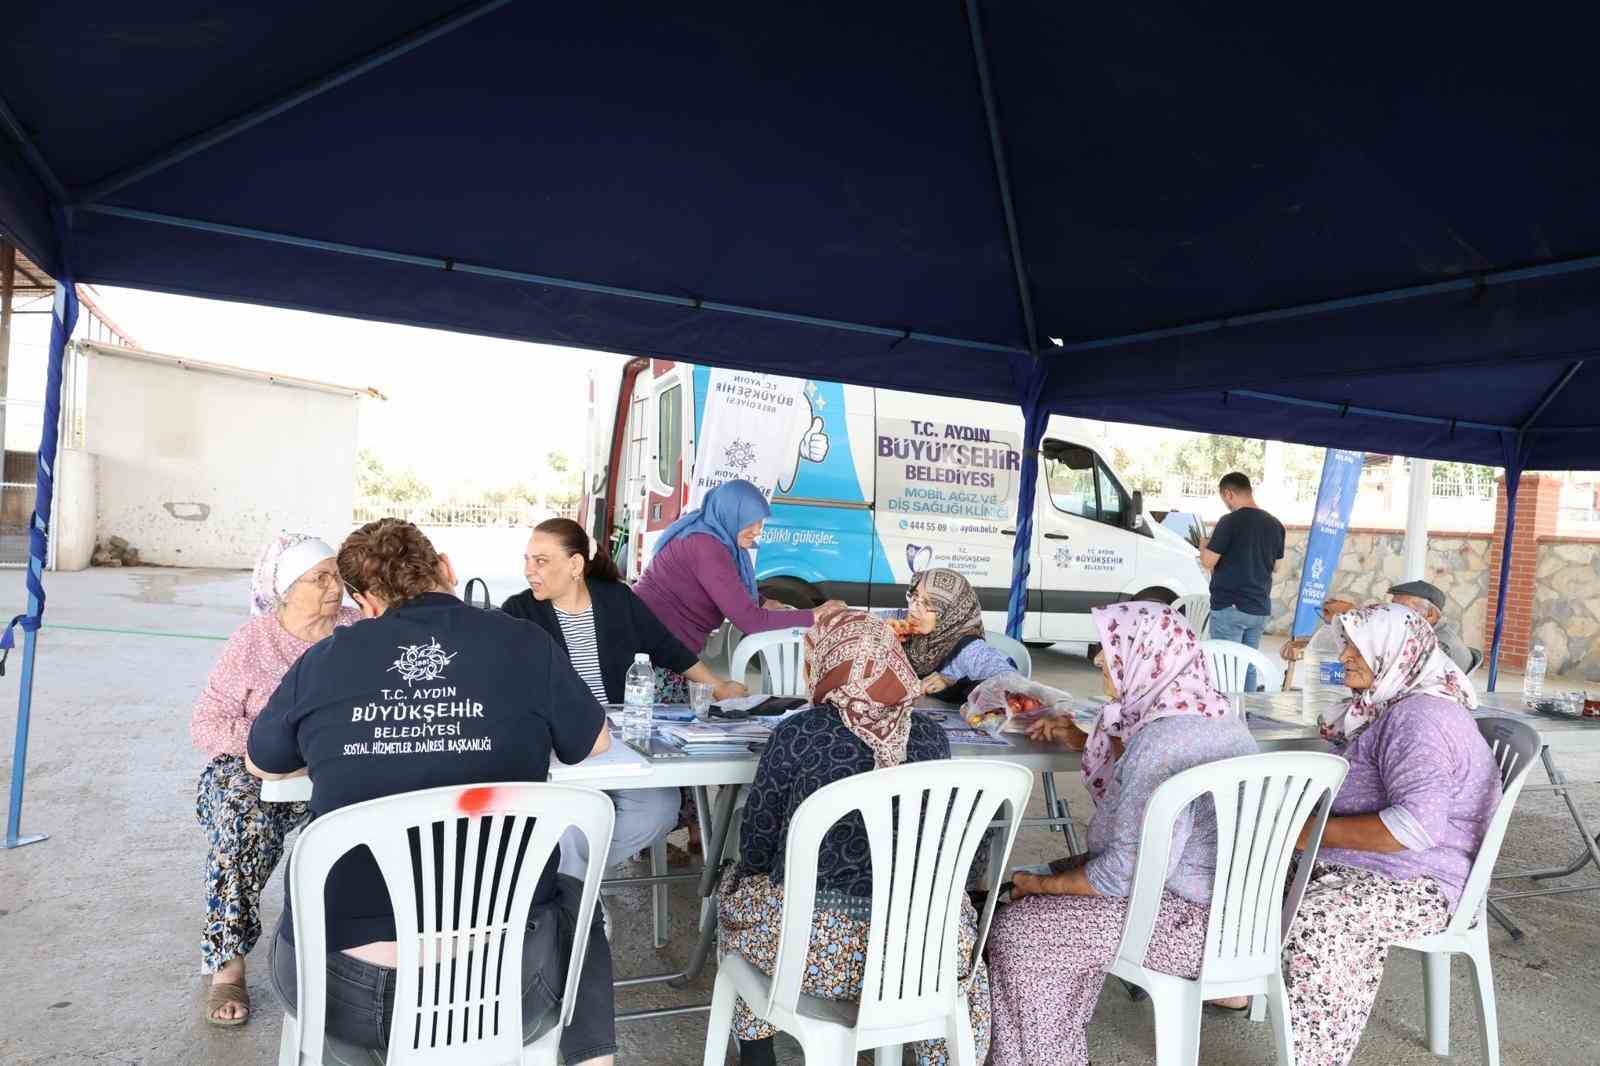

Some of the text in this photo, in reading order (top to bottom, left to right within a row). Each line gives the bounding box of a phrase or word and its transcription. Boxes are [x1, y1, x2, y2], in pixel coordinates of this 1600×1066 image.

[911, 420, 991, 442] T.C. AYDIN
[878, 435, 1021, 471] BÜYÜKŞEHİR
[905, 464, 995, 488] BELEDİYESİ
[904, 487, 946, 501] MOBİL
[980, 495, 997, 505] VE
[888, 499, 910, 513] DİŞ
[911, 500, 963, 514] SAĞLIĞI
[381, 686, 457, 700] T.C. AYDIN
[351, 698, 484, 723] BÜYÜKŞEHİR
[374, 721, 461, 739] BELEDİYESİ
[343, 736, 492, 755] SOSYAL HİZMETLER DAİRESİ BAŞKANLIĞI
